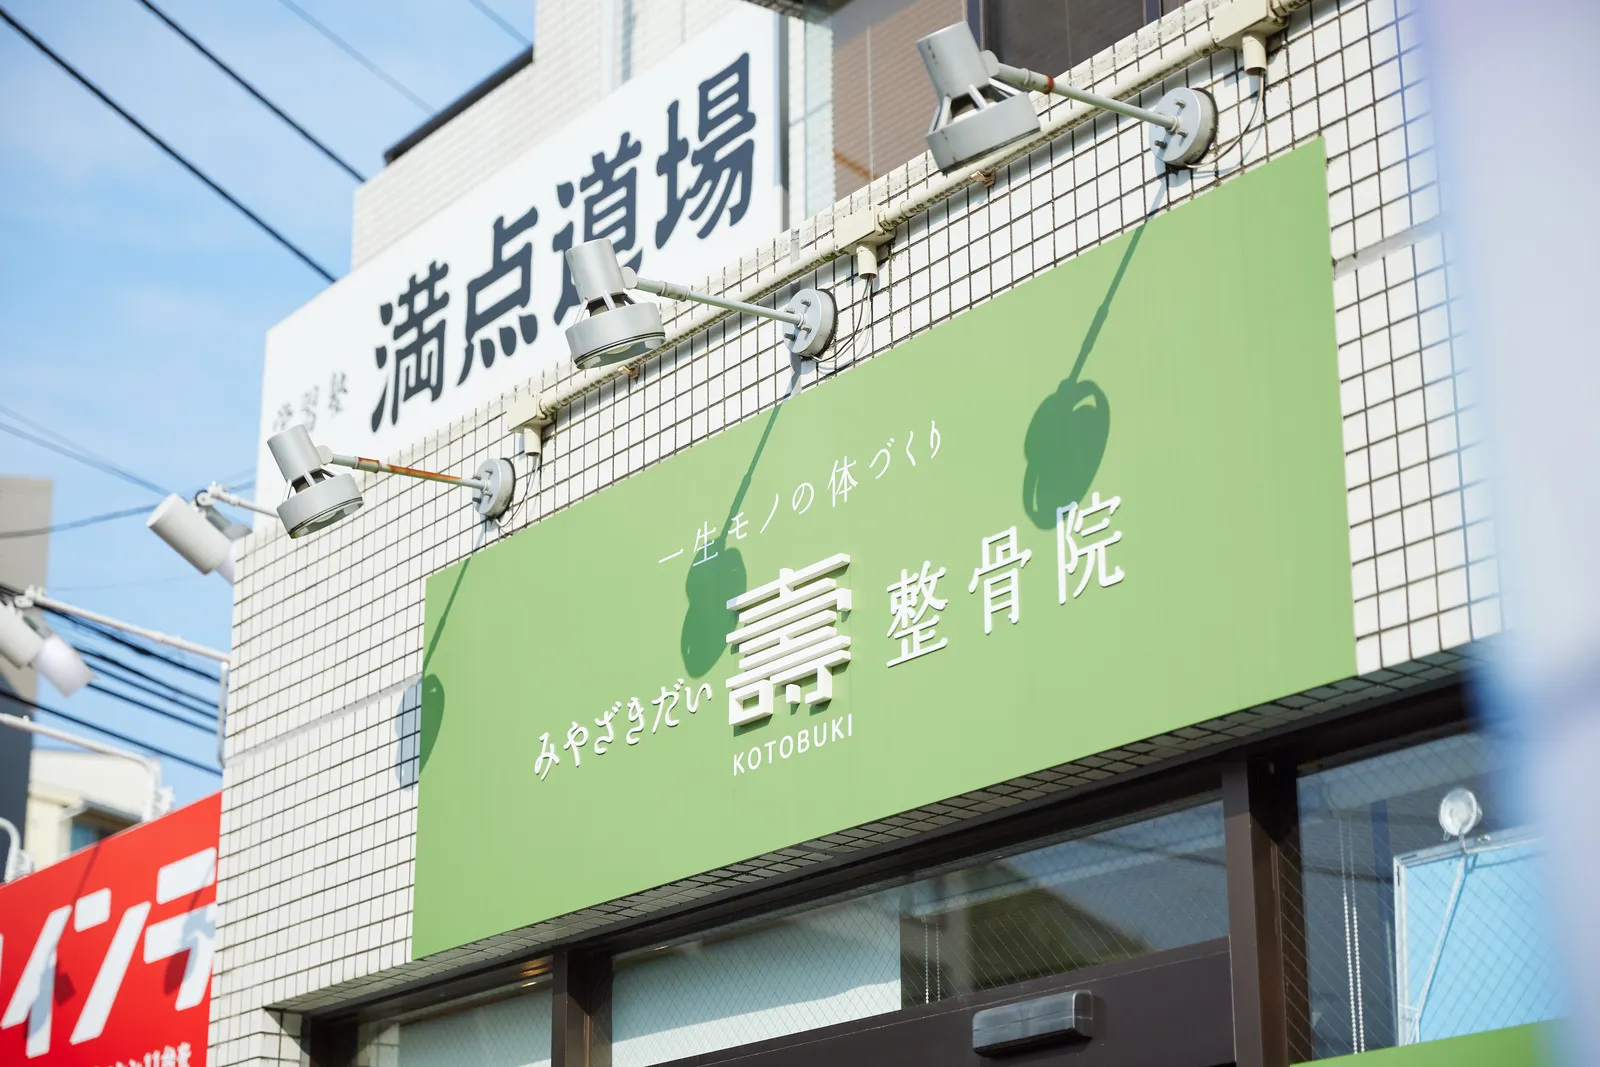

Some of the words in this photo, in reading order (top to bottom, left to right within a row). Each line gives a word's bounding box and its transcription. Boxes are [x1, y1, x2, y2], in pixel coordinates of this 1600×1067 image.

[371, 51, 757, 433] 満点道場
[657, 419, 943, 567] 一生モノの体づくり
[533, 678, 713, 781] みやざきだい
[885, 491, 1126, 668] 整骨院
[732, 713, 854, 777] KOTOBUKI
